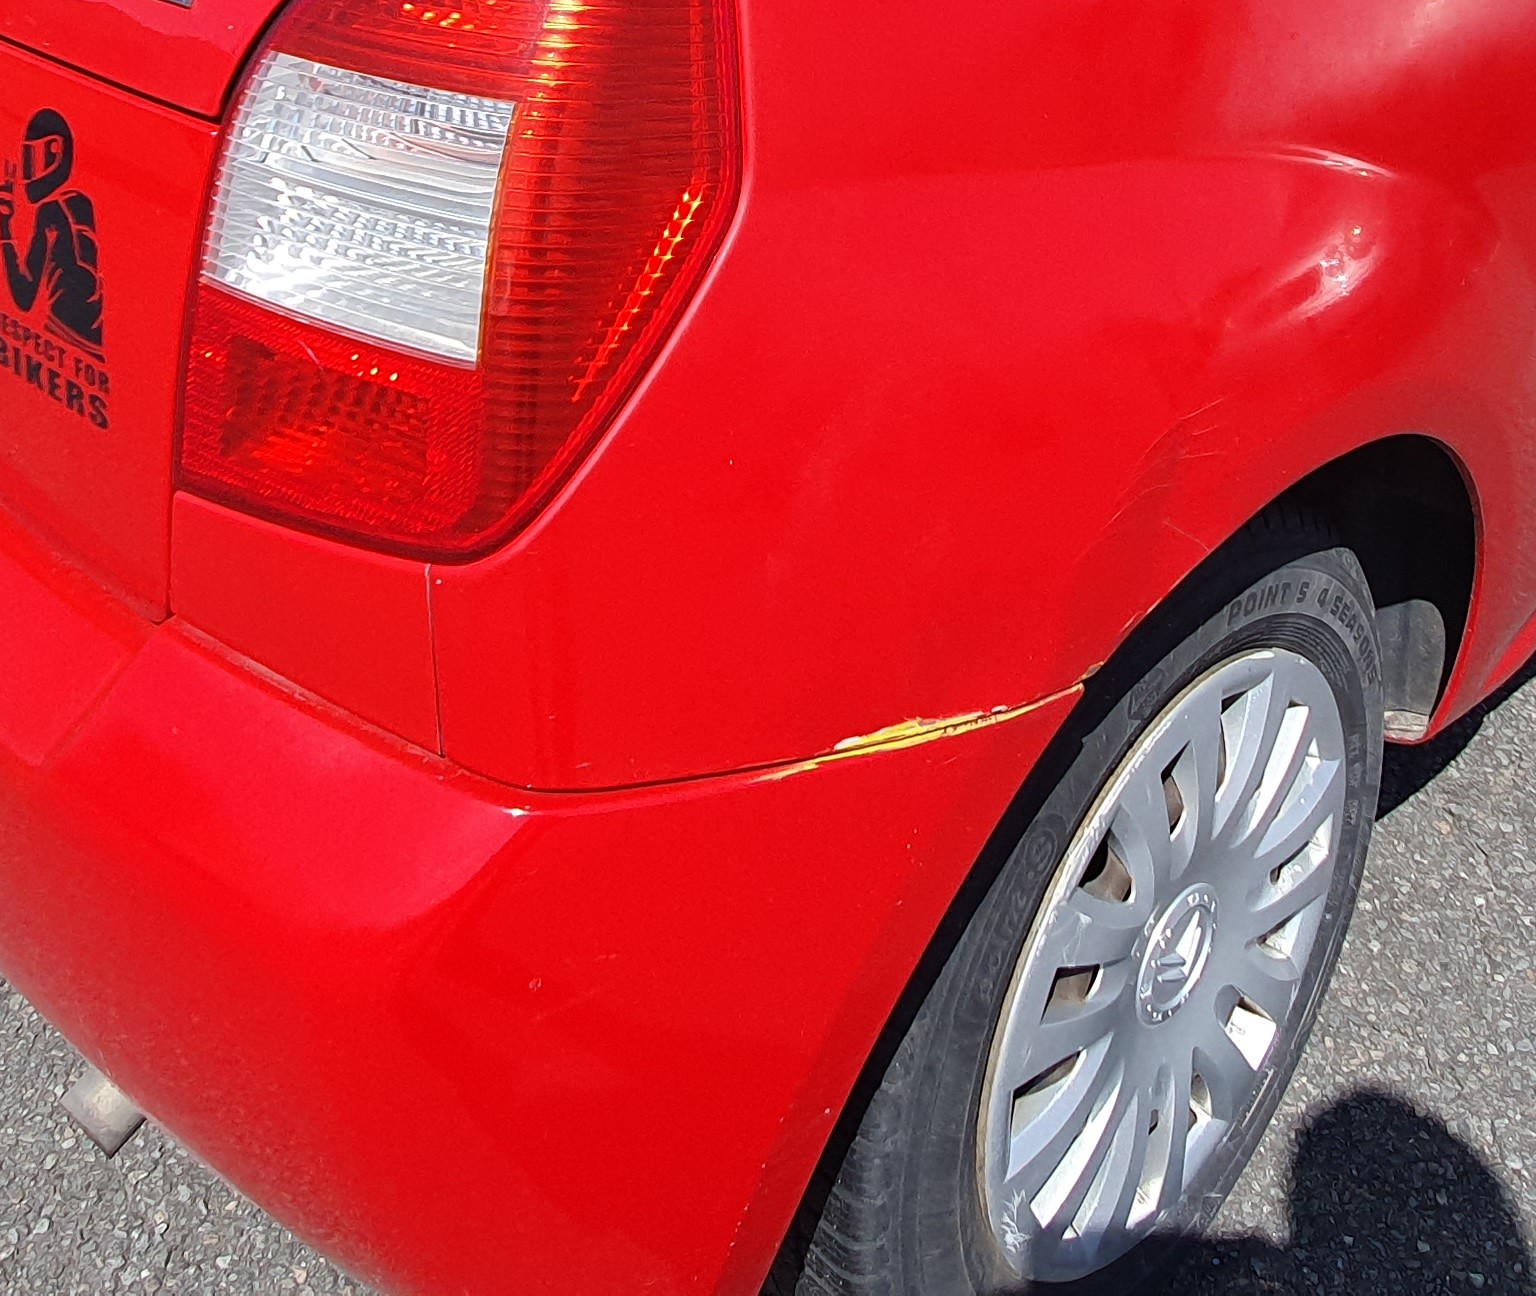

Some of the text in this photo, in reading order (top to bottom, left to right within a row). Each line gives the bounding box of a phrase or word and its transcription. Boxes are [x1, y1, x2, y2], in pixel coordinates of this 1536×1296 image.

[73, 357, 110, 395] FOR
[1227, 581, 1292, 627] POINT
[1295, 581, 1310, 604] S
[1316, 587, 1330, 609] 4
